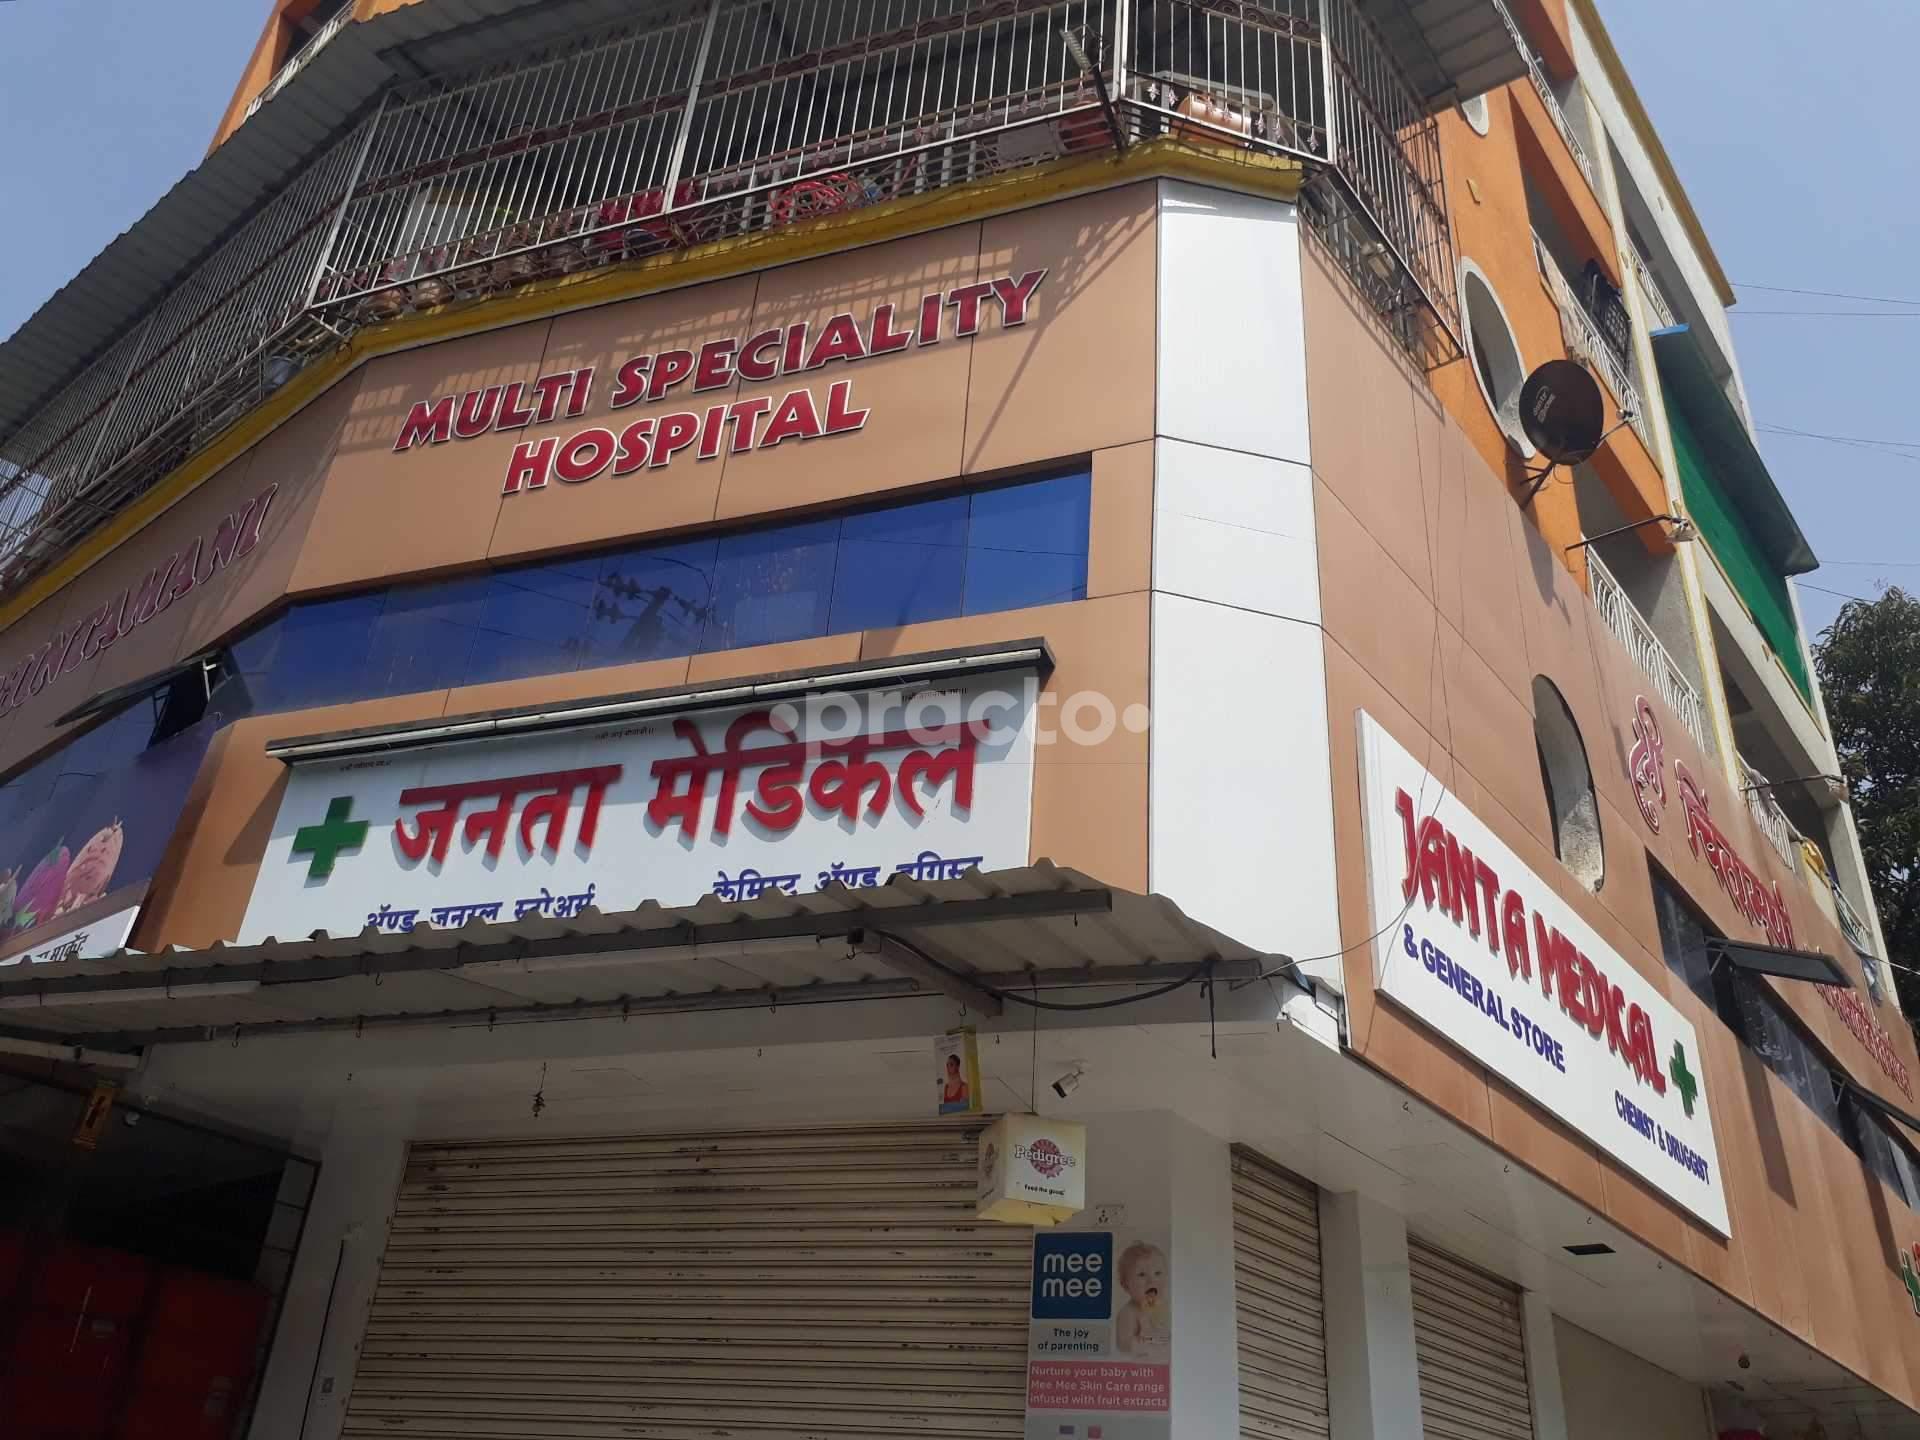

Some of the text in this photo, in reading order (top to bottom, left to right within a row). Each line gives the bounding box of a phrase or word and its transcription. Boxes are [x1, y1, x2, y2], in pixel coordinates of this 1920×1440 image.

[392, 267, 1050, 452] MULTI SPECIALITY
[502, 379, 871, 495] HOSPITAL
[394, 709, 992, 866] जनता मेडिकल
[1395, 785, 1532, 984] JANTA
[1533, 909, 1667, 1096] MEDICAL
[1403, 923, 1566, 1074] & GENERAL STORE
[1614, 1089, 1710, 1185] CHEMIST & DRUGGIST
[1014, 1144, 1076, 1168] Pedigree
[1043, 1252, 1103, 1273] mee
[1042, 1277, 1103, 1298] mee
[1053, 1327, 1090, 1339] The joy
[1037, 1341, 1100, 1353] of parenting
[1031, 1366, 1154, 1379] Nurture your baby with
[1080, 1380, 1102, 1391] Skin
[1105, 1381, 1131, 1392] Care
[1133, 1383, 1165, 1394] range
[1030, 1393, 1169, 1408] infused with fruit extracts
